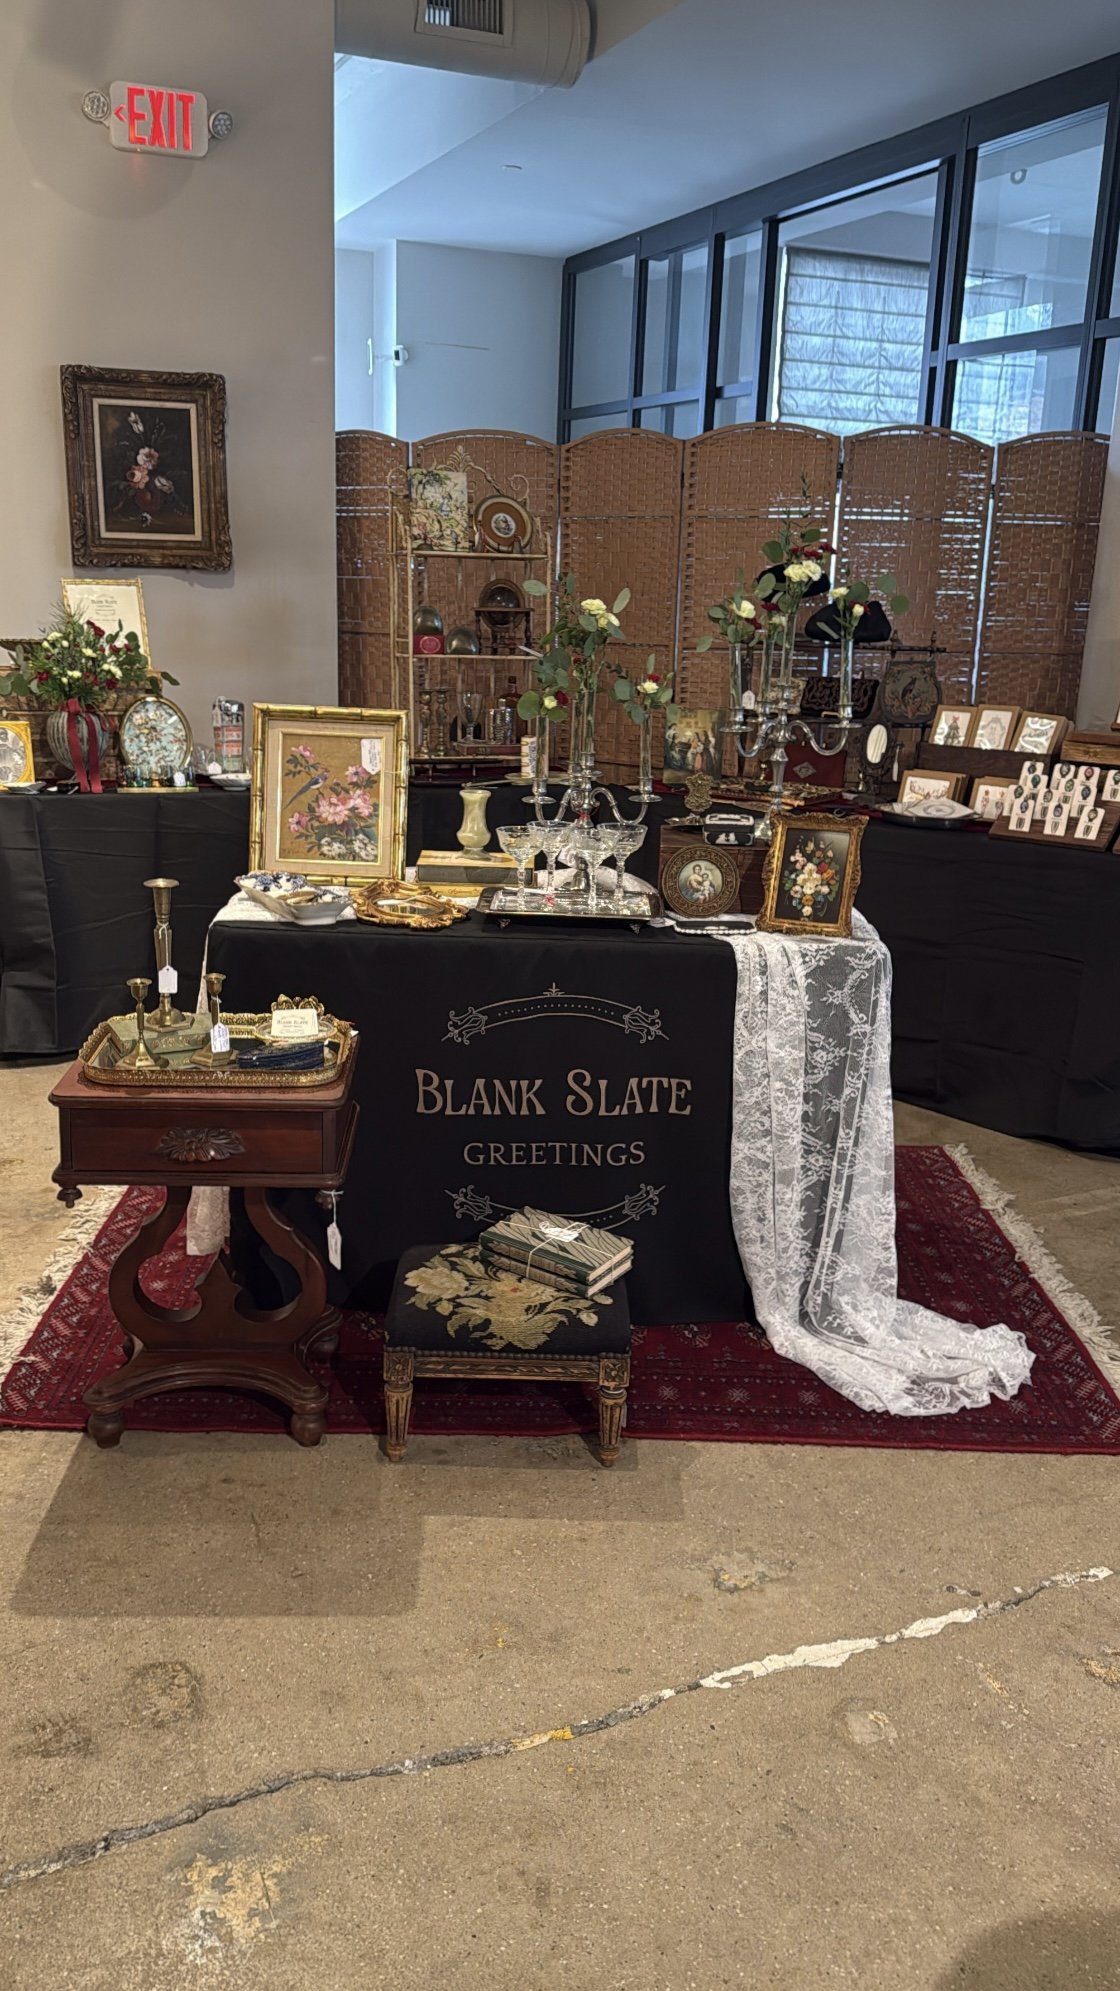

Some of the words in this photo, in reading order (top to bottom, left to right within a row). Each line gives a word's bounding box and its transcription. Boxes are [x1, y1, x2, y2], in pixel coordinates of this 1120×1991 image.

[127, 86, 196, 151] EXIT
[415, 1068, 546, 1116] BLANK
[565, 1068, 692, 1116] SLATE
[463, 1141, 646, 1167] GREETINGS
